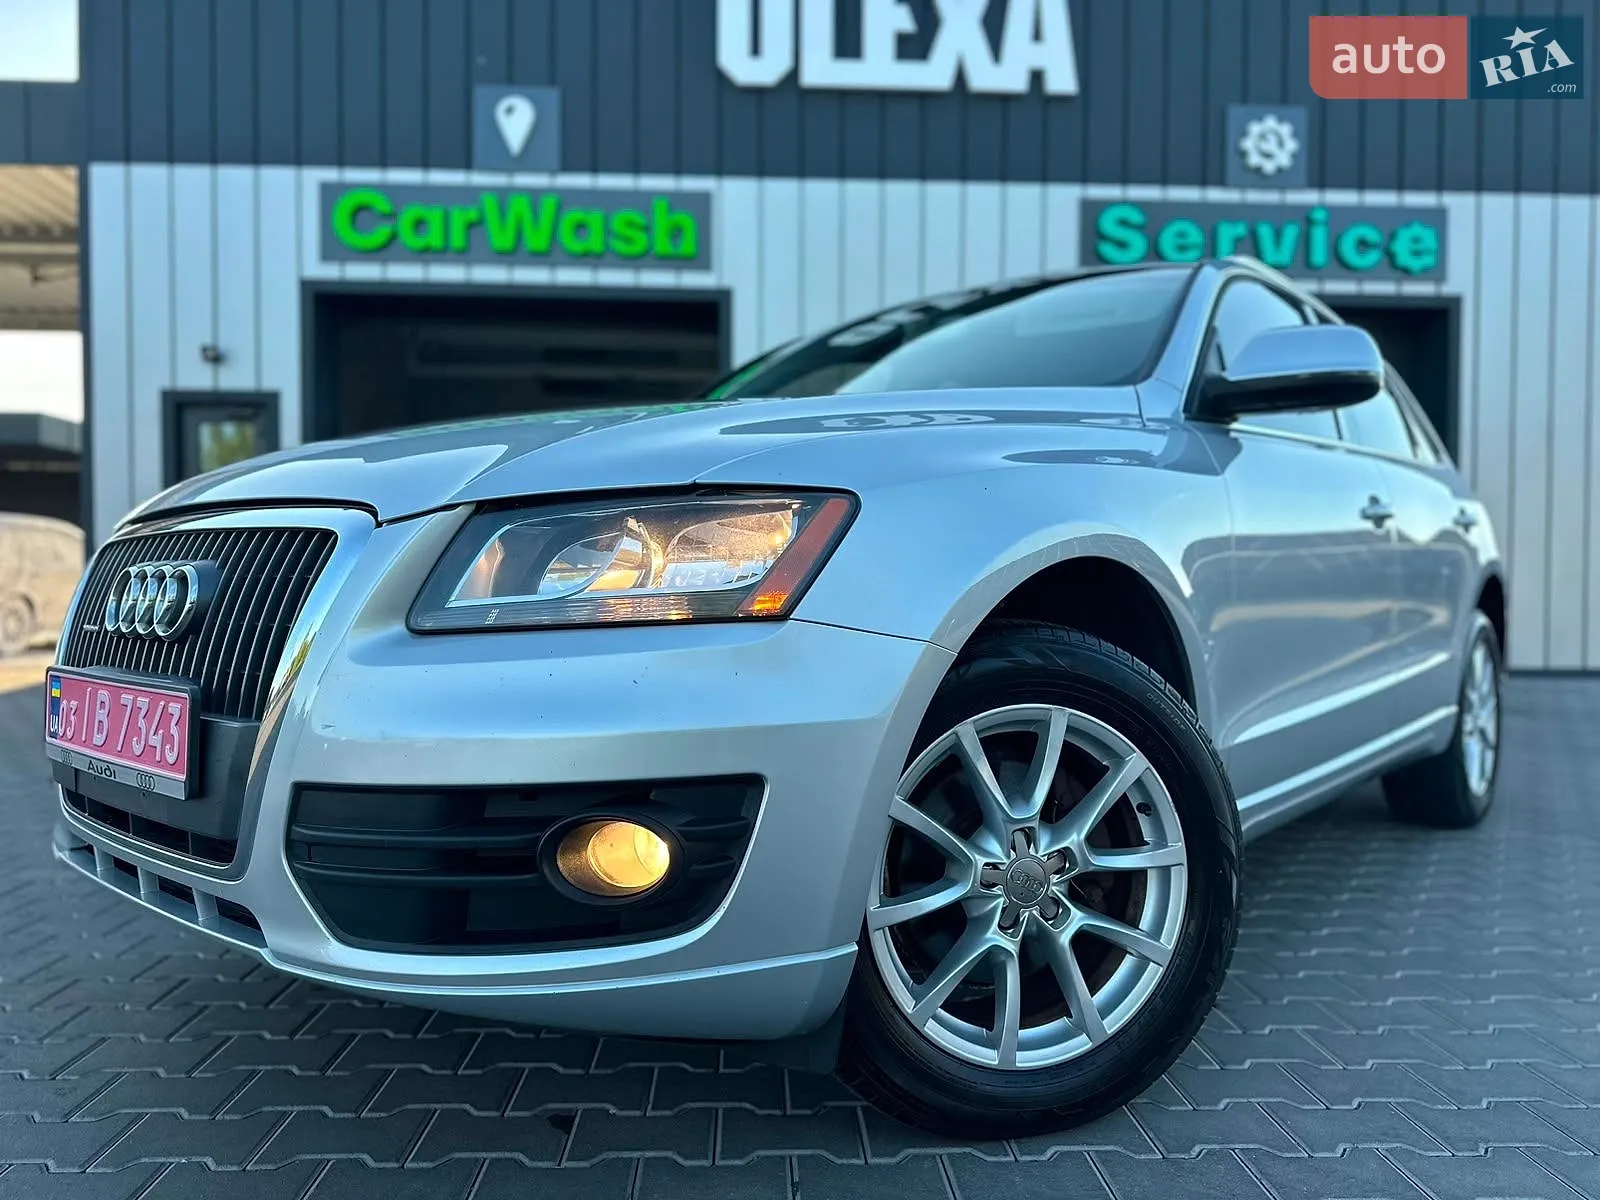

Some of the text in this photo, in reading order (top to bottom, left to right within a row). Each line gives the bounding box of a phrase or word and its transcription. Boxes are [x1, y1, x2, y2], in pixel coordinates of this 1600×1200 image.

[332, 187, 697, 259] CarWash
[1095, 203, 1439, 275] Service
[59, 699, 79, 739] 03
[117, 693, 182, 765] 7343
[87, 760, 117, 780] Audi
